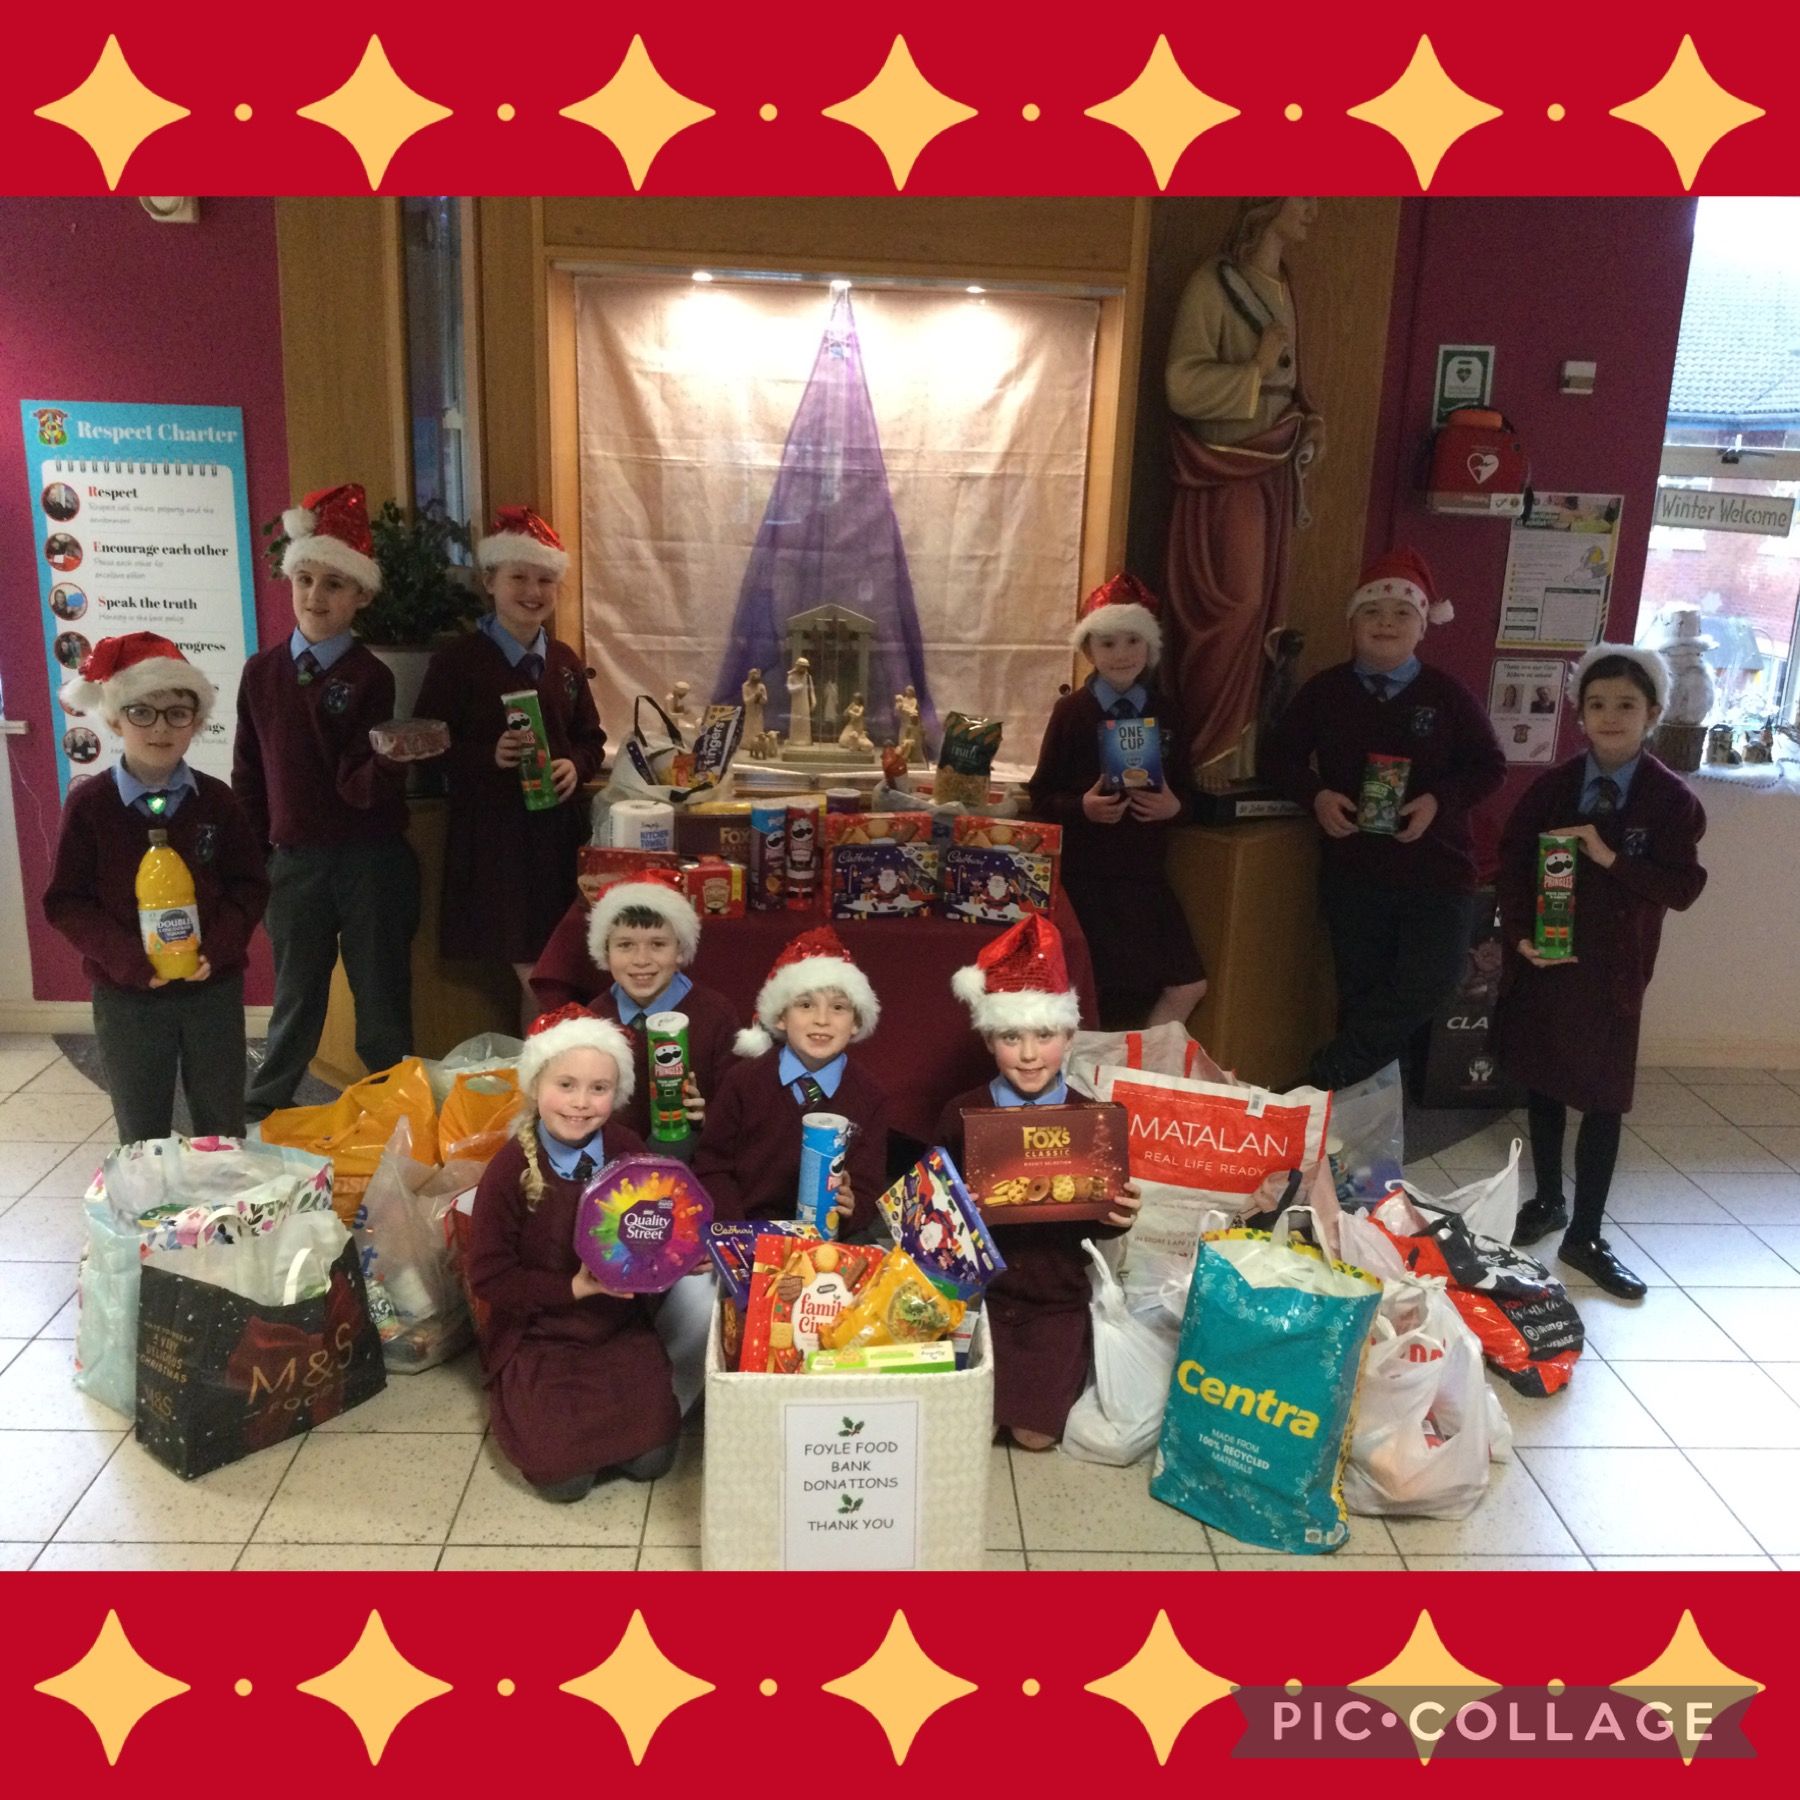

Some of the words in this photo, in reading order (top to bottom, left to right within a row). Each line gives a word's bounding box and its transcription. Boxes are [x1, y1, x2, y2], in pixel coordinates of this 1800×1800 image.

[77, 421, 152, 444] Respect
[158, 423, 238, 443] Charter
[88, 486, 138, 500] Respect
[1662, 494, 1715, 520] Winter
[1719, 497, 1787, 527] Welcome
[94, 541, 160, 556] Encourage
[162, 543, 190, 555] each
[194, 544, 228, 557] other
[98, 596, 137, 610] Speak
[140, 597, 160, 609] the
[163, 598, 197, 610] truth
[1118, 726, 1143, 739] ONE
[1120, 738, 1145, 751] CUP
[720, 827, 750, 844] FOX
[1544, 875, 1573, 889] PRINGLES
[1446, 1016, 1489, 1030] CLA
[1129, 1113, 1288, 1158] MATALAN
[1025, 1149, 1070, 1158] CLASSIC
[1144, 1151, 1178, 1167] REAL
[1184, 1158, 1213, 1172] LIFE
[1219, 1164, 1266, 1177] READY
[624, 1212, 671, 1229] Quality
[626, 1226, 663, 1240] Street
[711, 1222, 753, 1236] Cadbury
[800, 1293, 846, 1317] famil
[799, 1316, 829, 1334] Cir
[140, 1354, 188, 1384] CHRISTMAS
[247, 1322, 354, 1405] M&S
[1177, 1359, 1321, 1439] Centra
[804, 1442, 851, 1456] FOYLE
[855, 1441, 898, 1454] FOOD
[1211, 1428, 1235, 1444] MADE
[1236, 1438, 1260, 1454] FROM
[1198, 1433, 1221, 1450] 100%
[1222, 1444, 1270, 1470] RECYCLED
[831, 1460, 871, 1473] BANK
[1211, 1451, 1253, 1475] MATERIALS
[803, 1477, 898, 1491] DONATIONS
[808, 1520, 859, 1531] THANK
[862, 1518, 894, 1530] YOU
